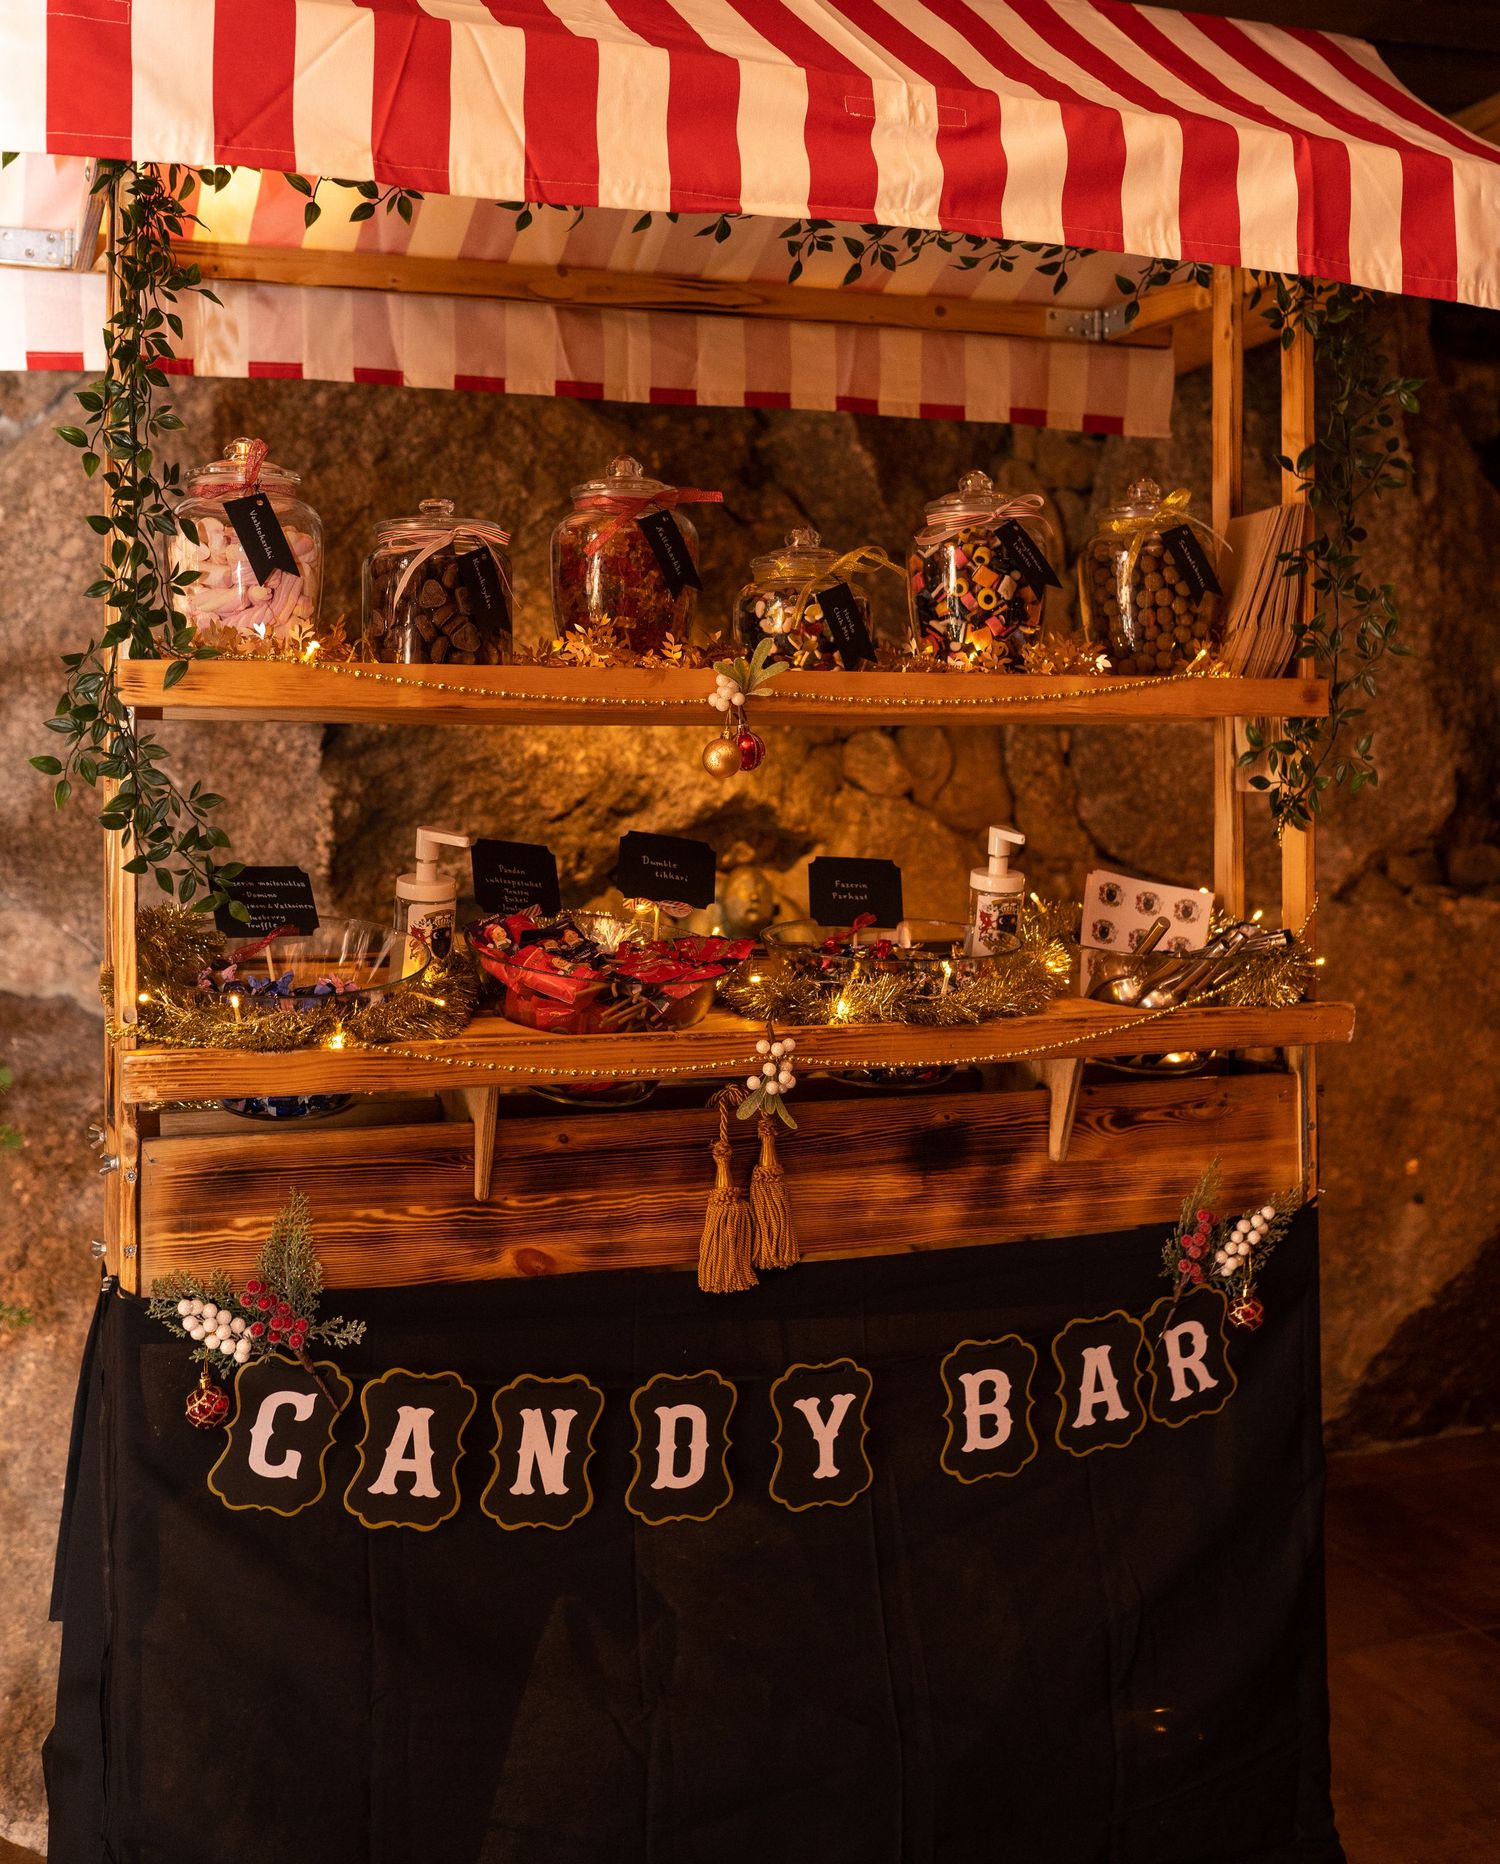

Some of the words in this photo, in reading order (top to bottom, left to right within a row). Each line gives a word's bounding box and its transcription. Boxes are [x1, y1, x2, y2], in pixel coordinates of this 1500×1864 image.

[641, 855, 678, 869] Dumble
[834, 879, 868, 889] Fazerin
[246, 891, 278, 899] Domino
[274, 902, 315, 910] Valkoinen
[247, 1389, 857, 1499] CANDY
[957, 1319, 1220, 1454] BAR
